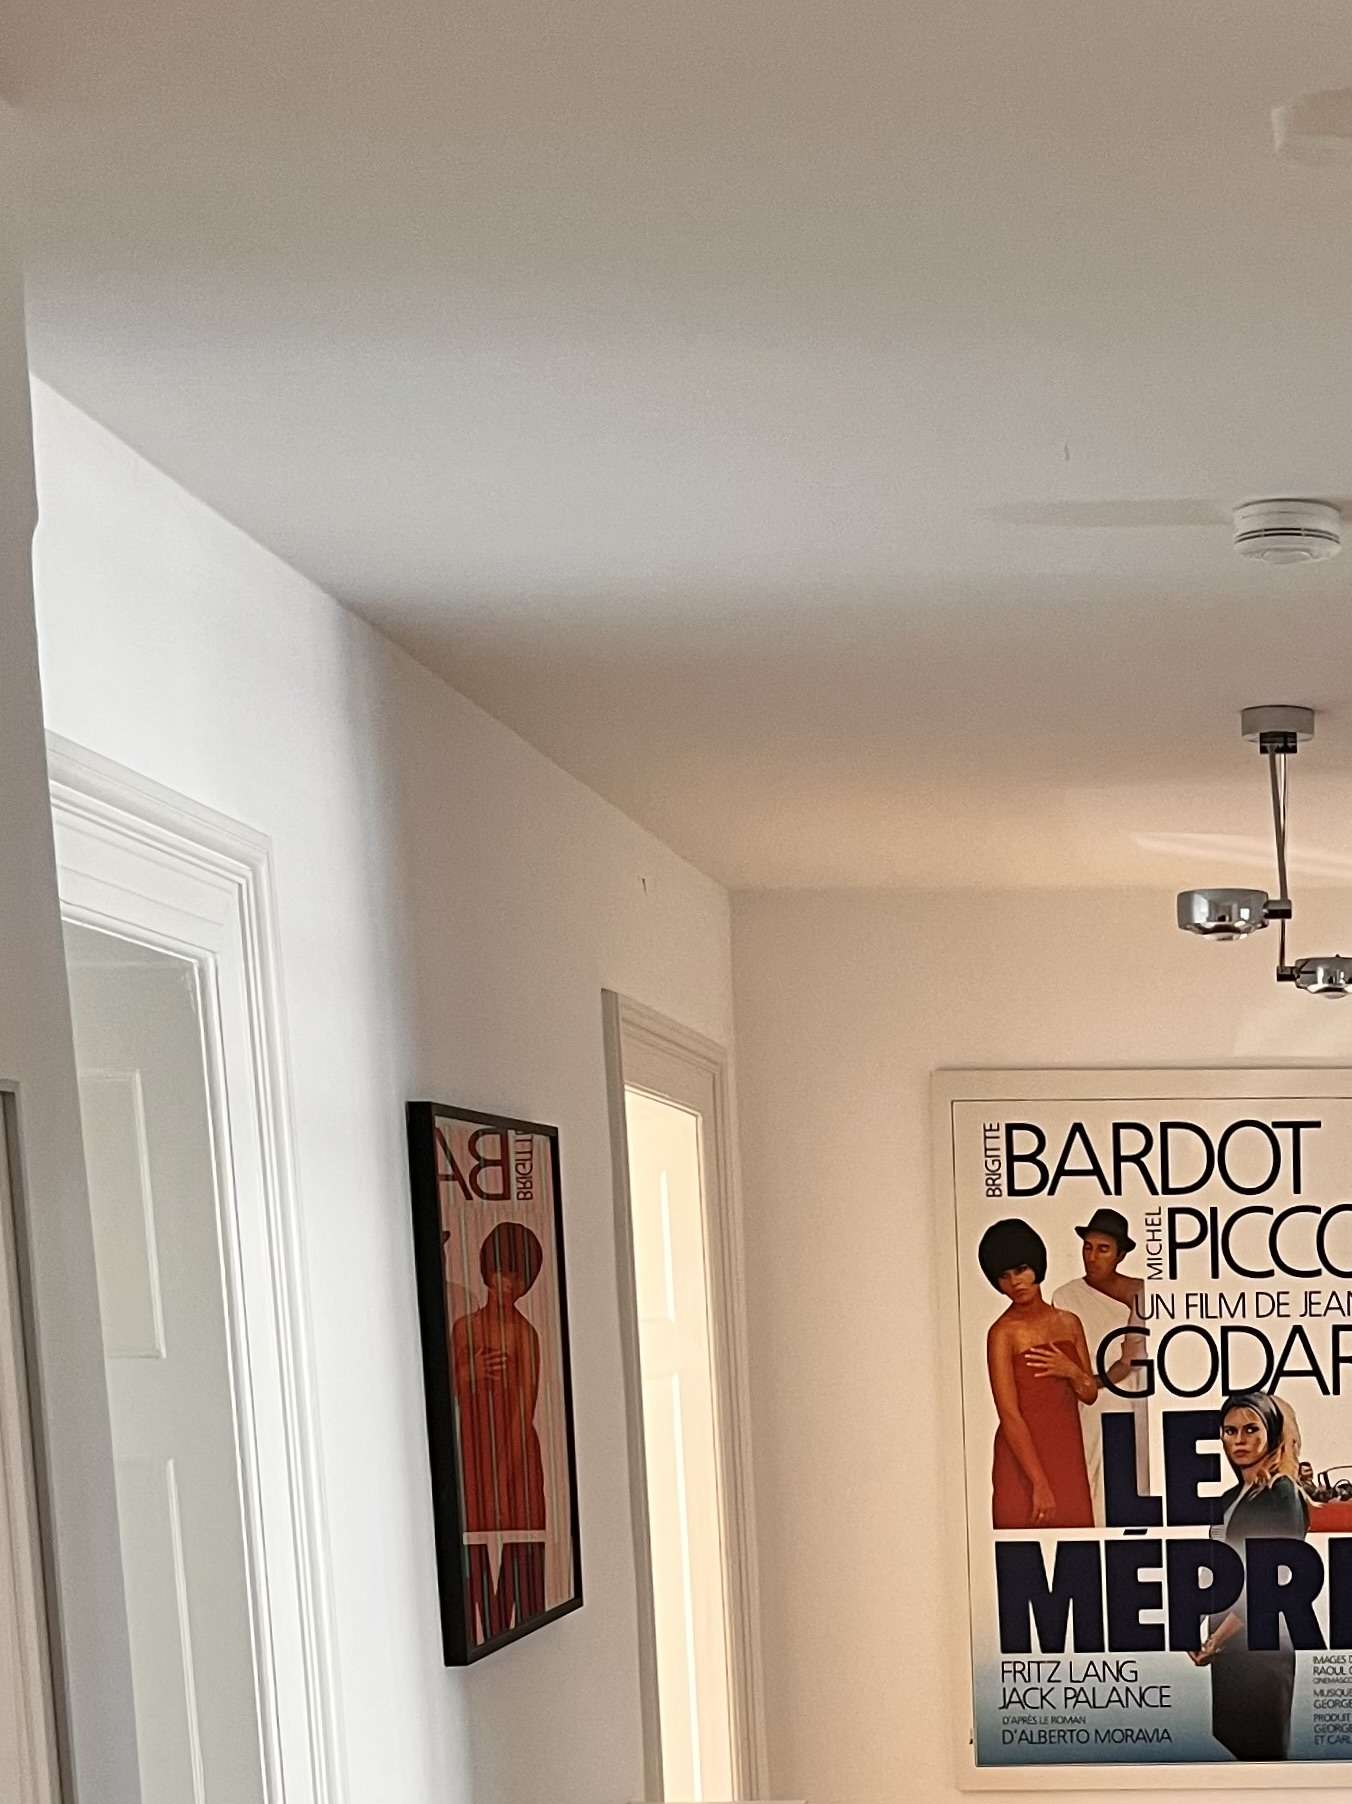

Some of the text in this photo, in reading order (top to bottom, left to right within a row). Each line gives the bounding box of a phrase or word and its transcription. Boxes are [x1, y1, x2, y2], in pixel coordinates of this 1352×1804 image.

[985, 1121, 1002, 1198] BRIGITTE
[1004, 1119, 1322, 1196] BARDOT
[1147, 1206, 1162, 1281] MICHEL
[1134, 1293, 1175, 1320] UN
[1185, 1291, 1246, 1319] FILM
[1256, 1290, 1290, 1318] DE
[1101, 1410, 1223, 1528] LE
[1313, 1655, 1347, 1664] IMAGES
[1313, 1665, 1346, 1675] RAOUL
[1001, 1660, 1138, 1684] FRITZ LANG
[998, 1685, 1172, 1710] JACK PALANCE
[1039, 1716, 1049, 1725] LE
[1051, 1715, 1086, 1725] ROMAN
[1313, 1712, 1350, 1722] PRODUIT
[1002, 1727, 1173, 1745] D'ALBERTO MORAVIA
[1314, 1735, 1325, 1746] ET
